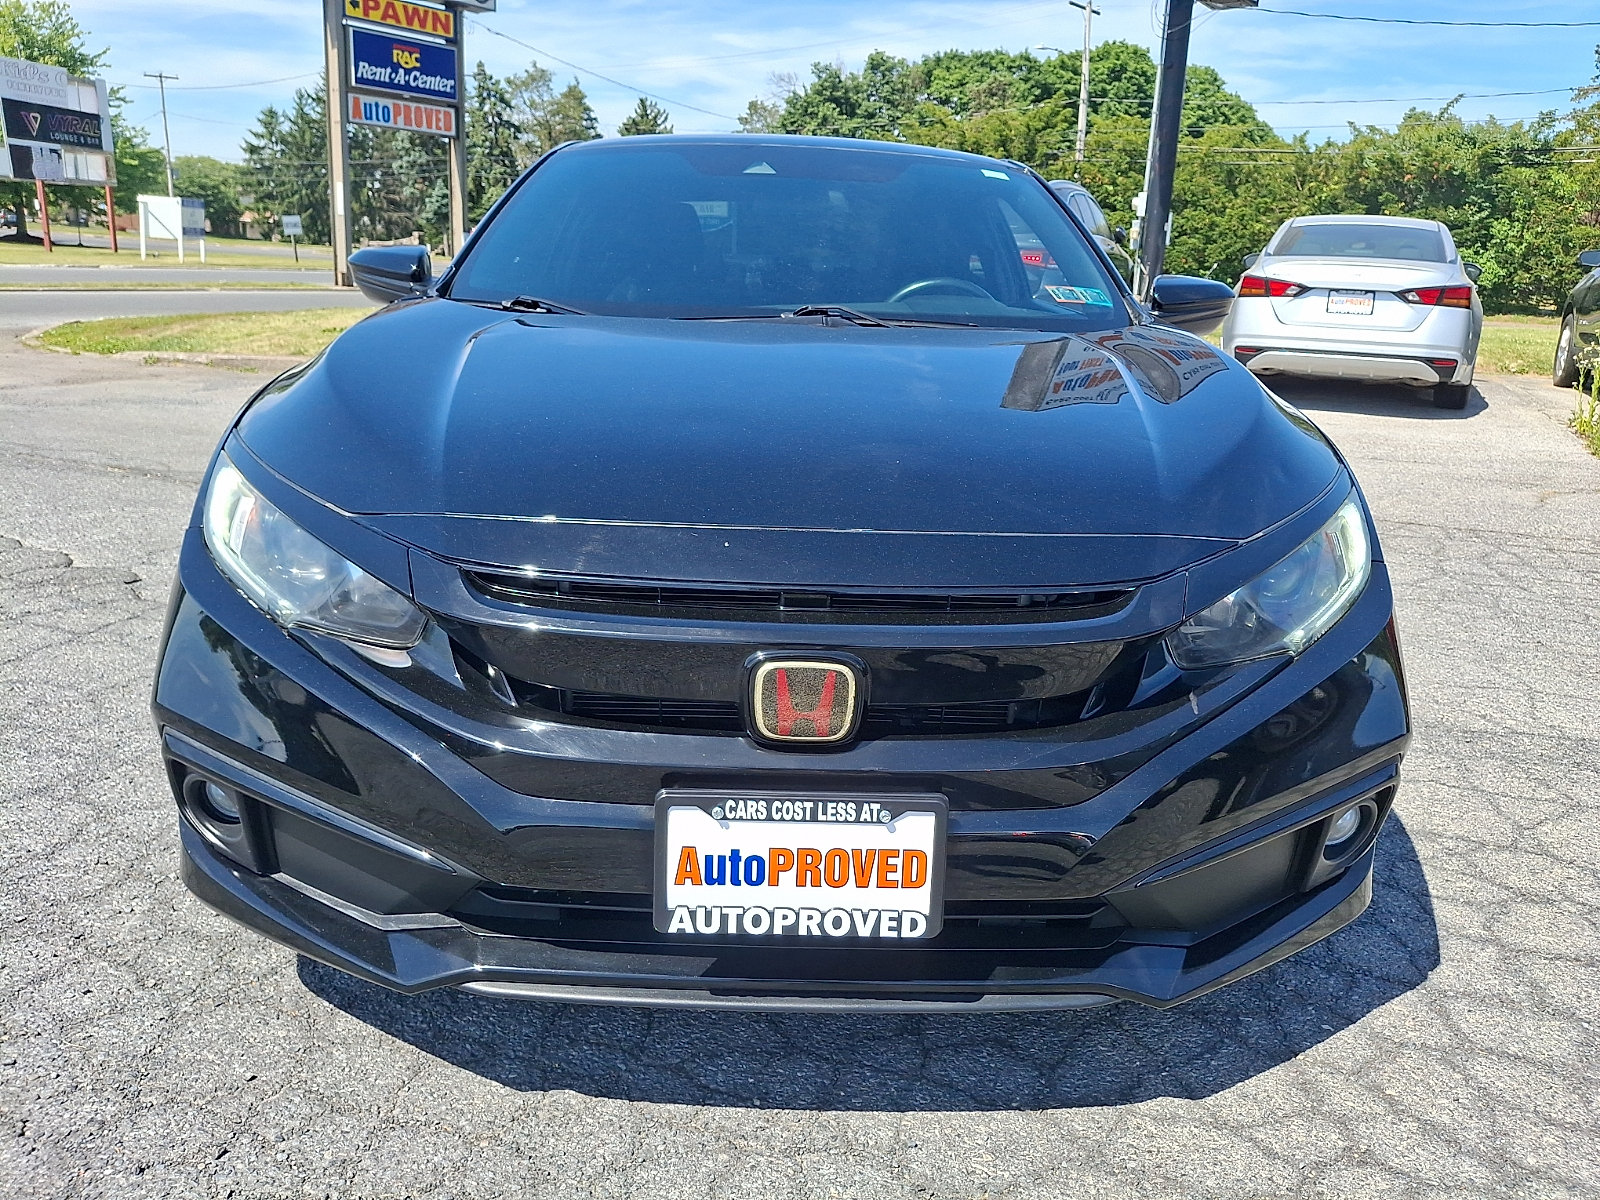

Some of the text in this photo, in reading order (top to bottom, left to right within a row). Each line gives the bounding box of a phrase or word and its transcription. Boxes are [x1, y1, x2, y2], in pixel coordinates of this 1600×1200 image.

[362, 0, 450, 35] PAWN
[47, 113, 101, 137] VYRAL
[352, 96, 453, 132] AutoPROVED
[50, 131, 78, 143] LOUNGE
[725, 799, 881, 822] CARS COST LESS AT
[674, 846, 928, 889] AutoPROVED
[668, 905, 928, 938] AUTOPROVED
